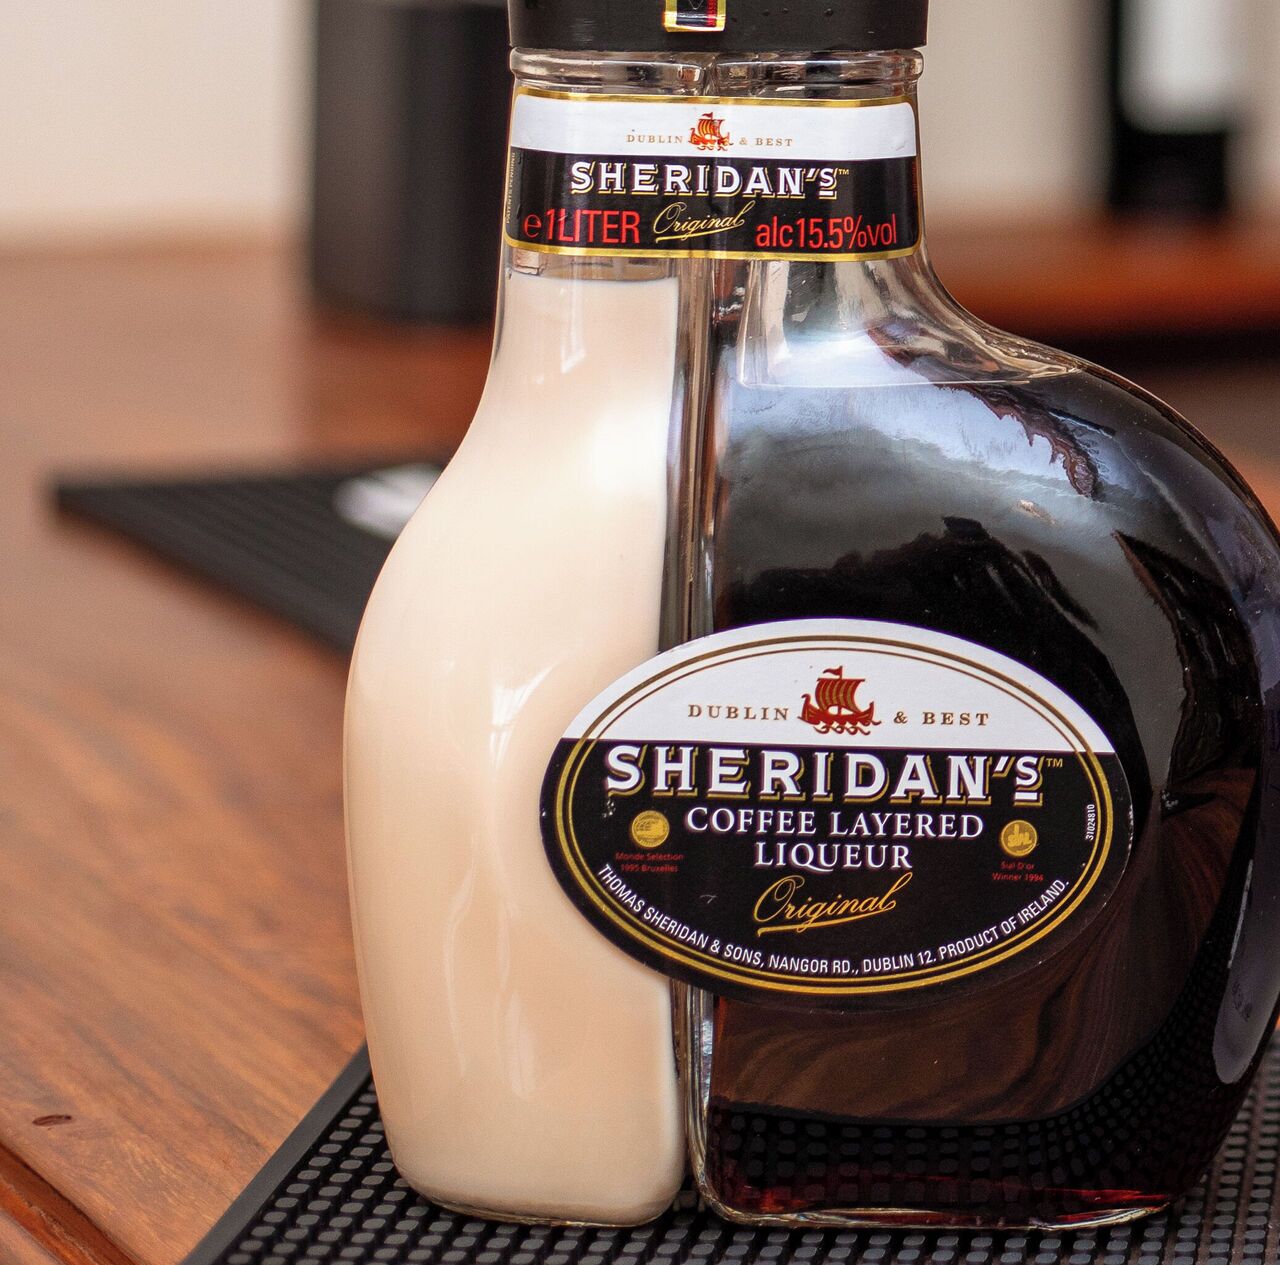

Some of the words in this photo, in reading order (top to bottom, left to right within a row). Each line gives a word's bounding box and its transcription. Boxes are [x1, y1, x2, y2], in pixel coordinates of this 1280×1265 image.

[626, 133, 684, 144] DUBLIN
[739, 137, 749, 147] &
[755, 136, 793, 148] BEST
[651, 201, 756, 244] Original
[687, 703, 790, 721] DUBLIN
[893, 711, 908, 725] &
[922, 711, 990, 728] BEST
[684, 805, 818, 837] COFFEE
[830, 808, 985, 840] LAYERED
[754, 841, 913, 873] LIQUEUR
[597, 863, 646, 913] THOMAS
[643, 906, 710, 949] SHERIDAN
[710, 939, 721, 953] &
[723, 943, 766, 968] SONS,
[767, 953, 829, 974] NANGOR
[832, 959, 860, 975] RD.,
[863, 953, 916, 973] DUBLIN
[917, 950, 937, 966] 12.
[938, 925, 1001, 960] PRODUCT
[1000, 915, 1019, 936] OF
[1016, 878, 1070, 925] IRELAND.
[753, 871, 914, 936] Original
